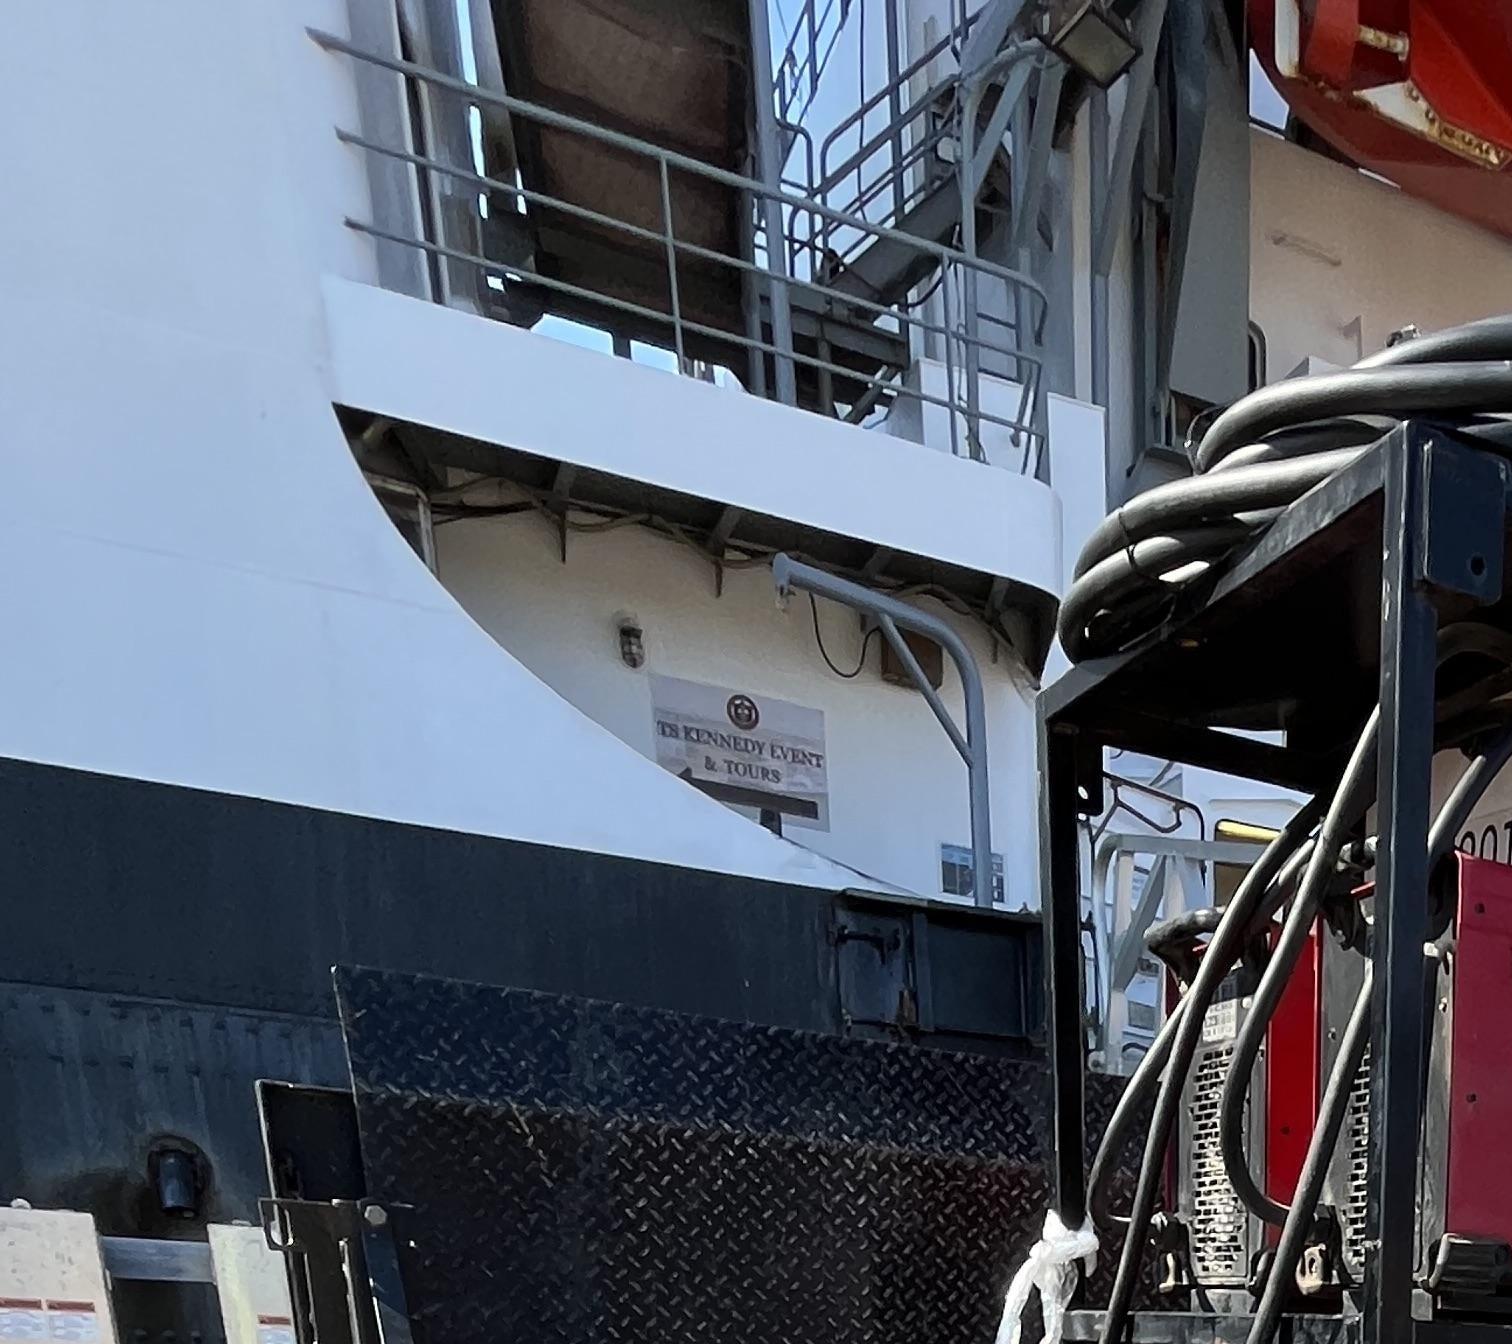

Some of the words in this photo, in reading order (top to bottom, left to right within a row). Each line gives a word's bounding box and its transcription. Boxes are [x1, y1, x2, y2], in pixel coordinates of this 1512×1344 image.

[658, 720, 679, 738] TS
[683, 724, 766, 754] KENNEDY
[769, 743, 824, 769] EVENT
[704, 756, 718, 771] &
[724, 759, 781, 783] TOURS
